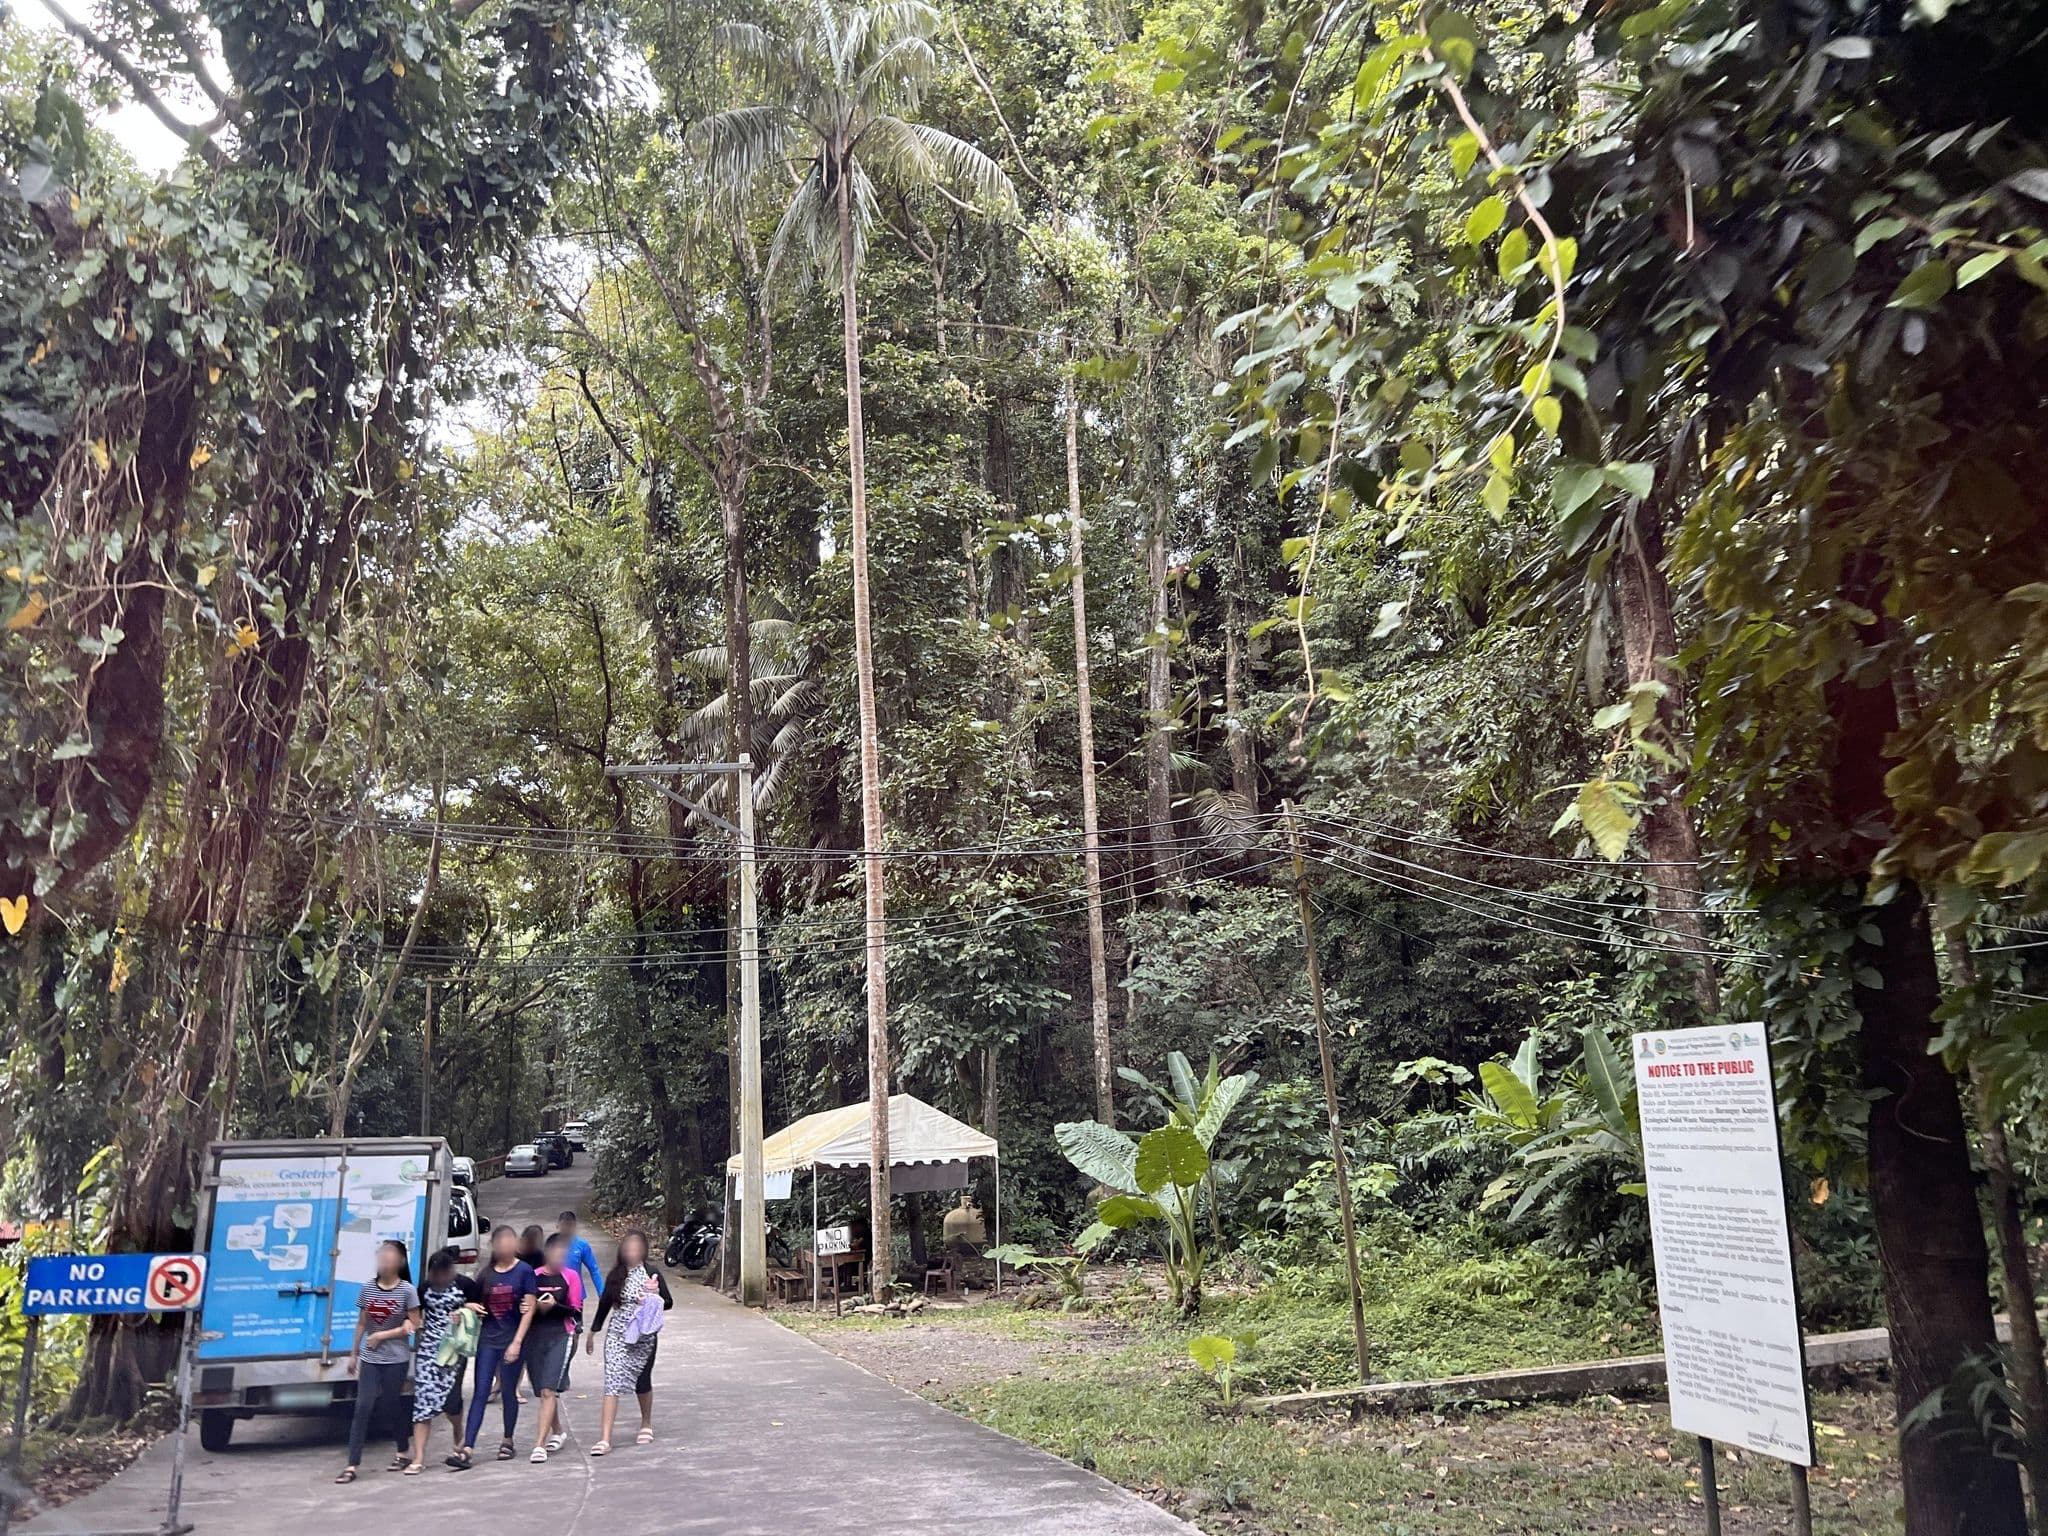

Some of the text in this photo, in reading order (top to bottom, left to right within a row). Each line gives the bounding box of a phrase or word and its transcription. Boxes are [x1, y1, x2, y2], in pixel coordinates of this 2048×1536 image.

[1647, 1059, 1754, 1077] NOTICE TO THE PUBLIC
[69, 1263, 105, 1281] NO
[26, 1287, 142, 1307] PARKING
